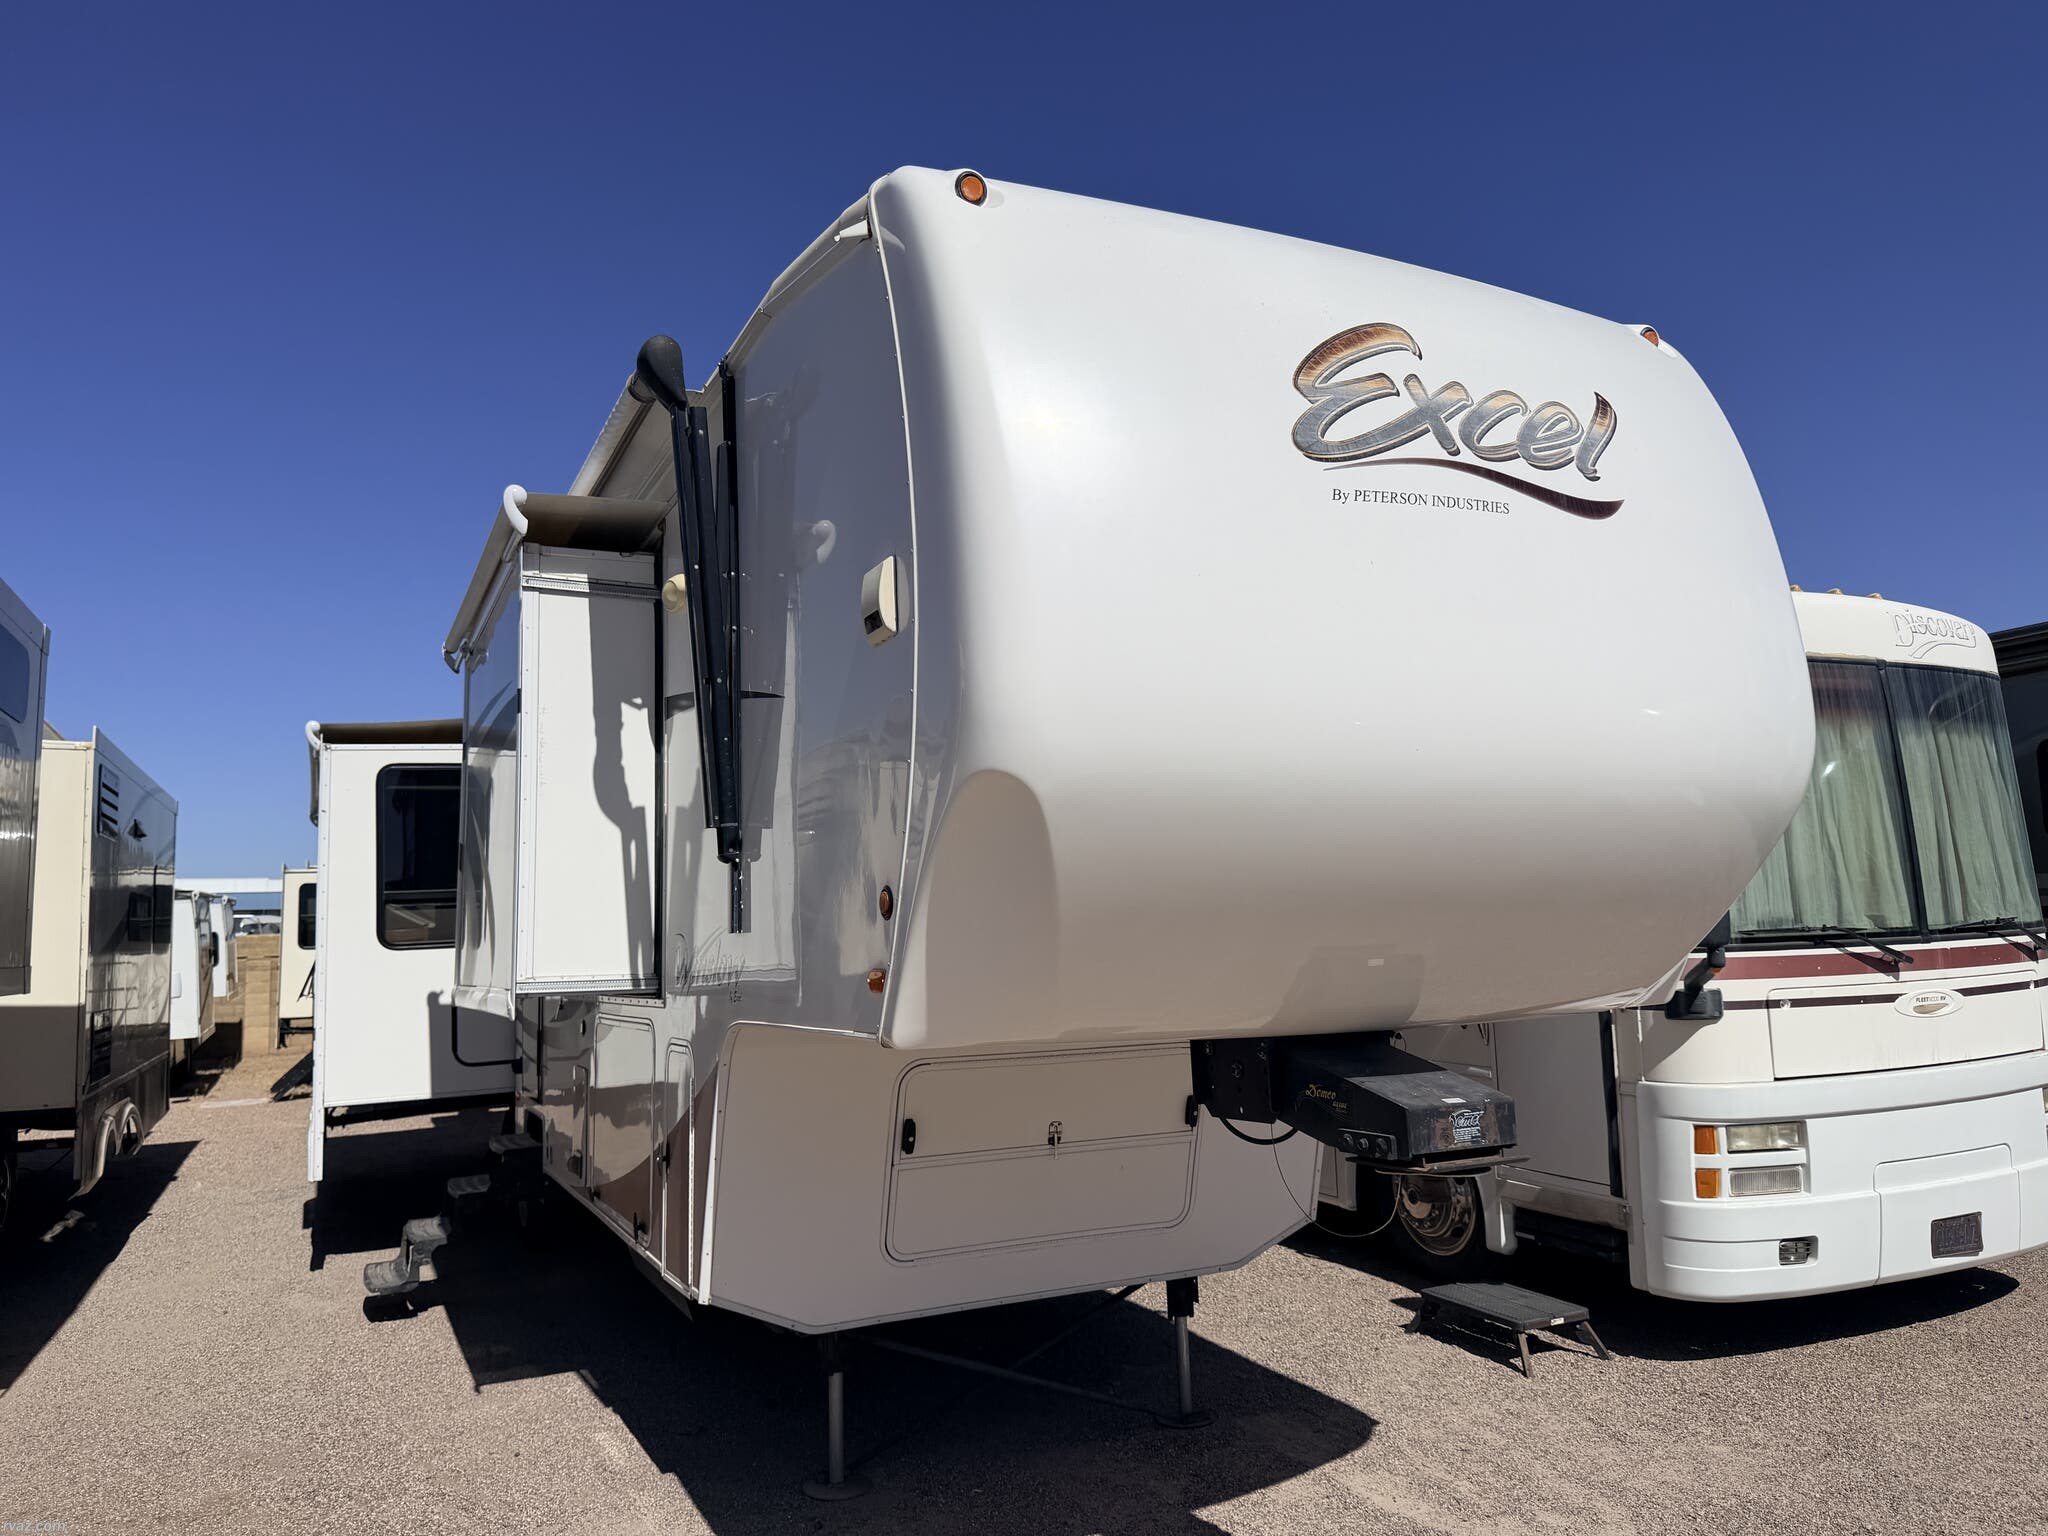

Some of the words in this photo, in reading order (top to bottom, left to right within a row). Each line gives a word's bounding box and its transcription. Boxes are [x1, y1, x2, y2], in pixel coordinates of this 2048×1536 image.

[1292, 322, 1617, 481] Excel
[1332, 488, 1350, 504] By
[1354, 489, 1428, 506] PETERSON
[1432, 495, 1510, 515] INDUSTRIES
[1889, 608, 1977, 655] Discovery
